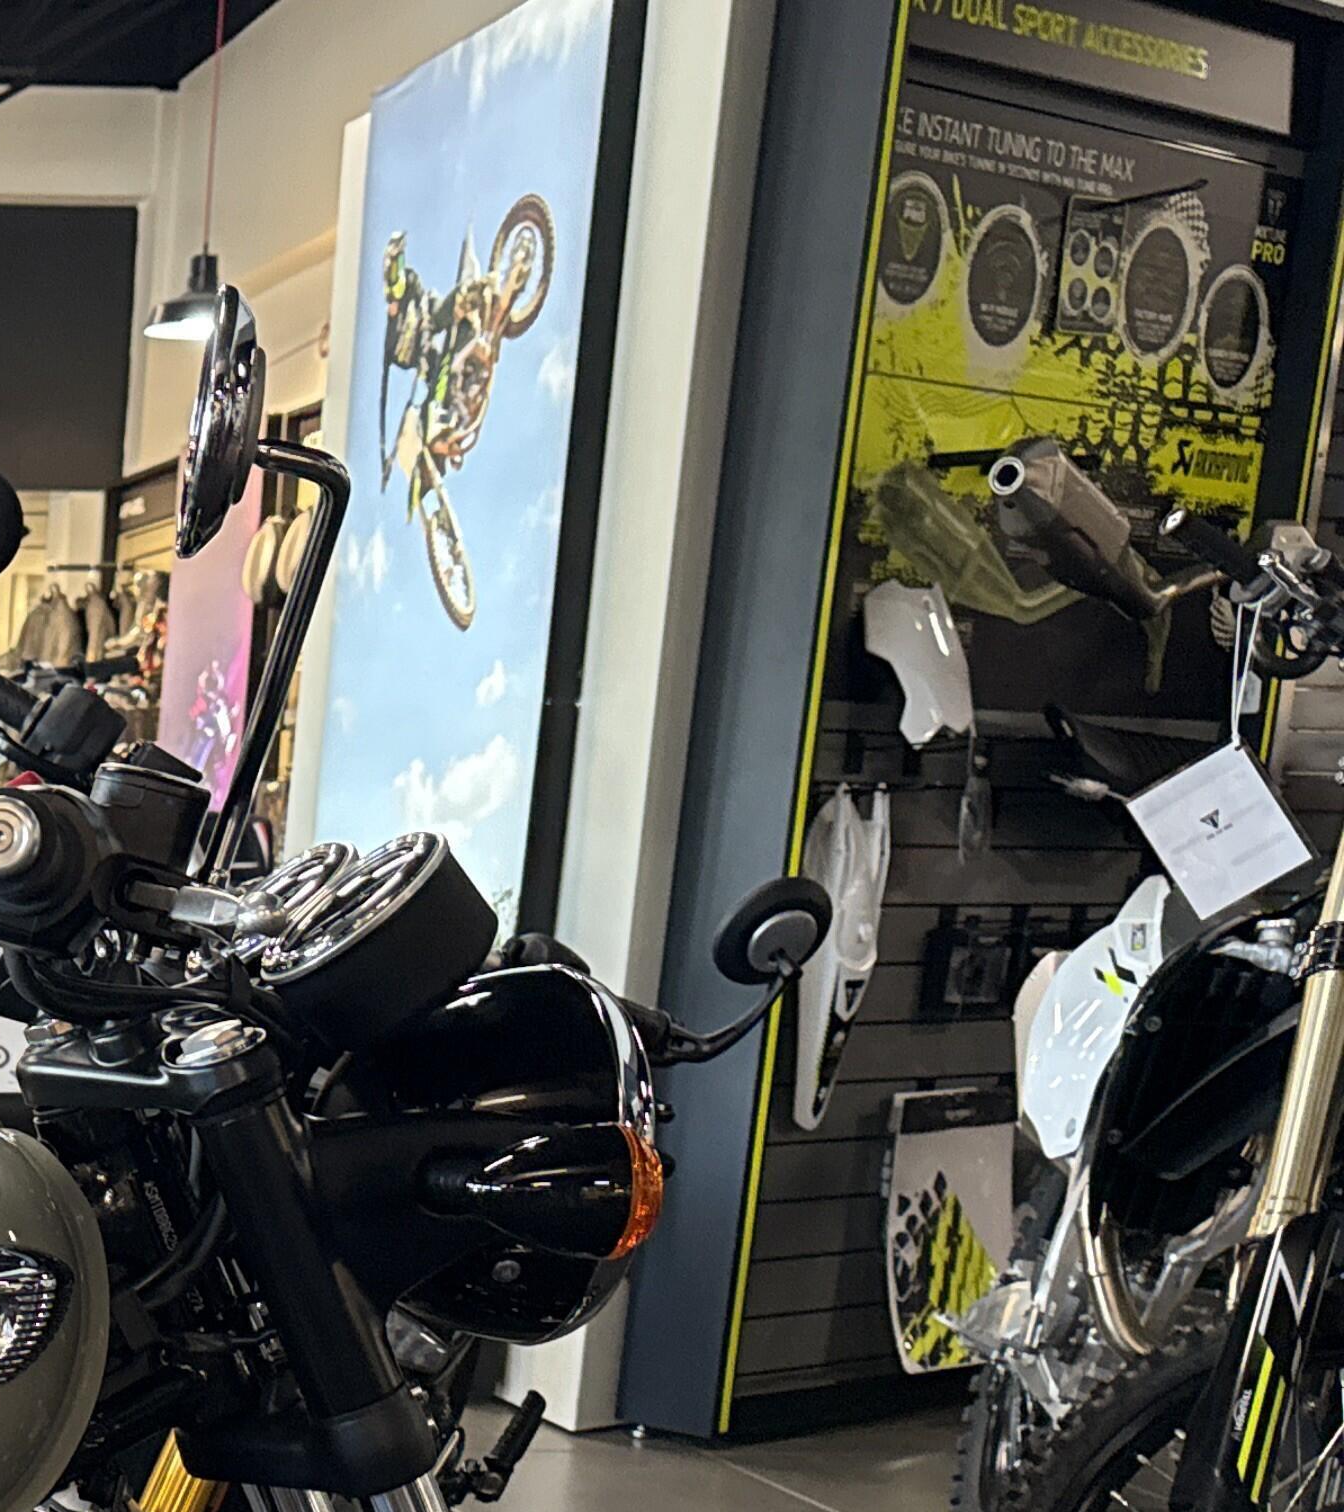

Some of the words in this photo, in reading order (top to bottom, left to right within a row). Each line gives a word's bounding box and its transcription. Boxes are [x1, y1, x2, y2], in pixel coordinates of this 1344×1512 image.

[1013, 4, 1078, 48] SPORT
[1082, 22, 1209, 80] ACCESSORIES
[917, 111, 983, 149] INSTANT
[987, 126, 1041, 163] TUNING
[1046, 139, 1066, 168] TO
[1069, 145, 1098, 176] THE
[1100, 151, 1137, 184] MAX
[1250, 240, 1286, 265] PRO
